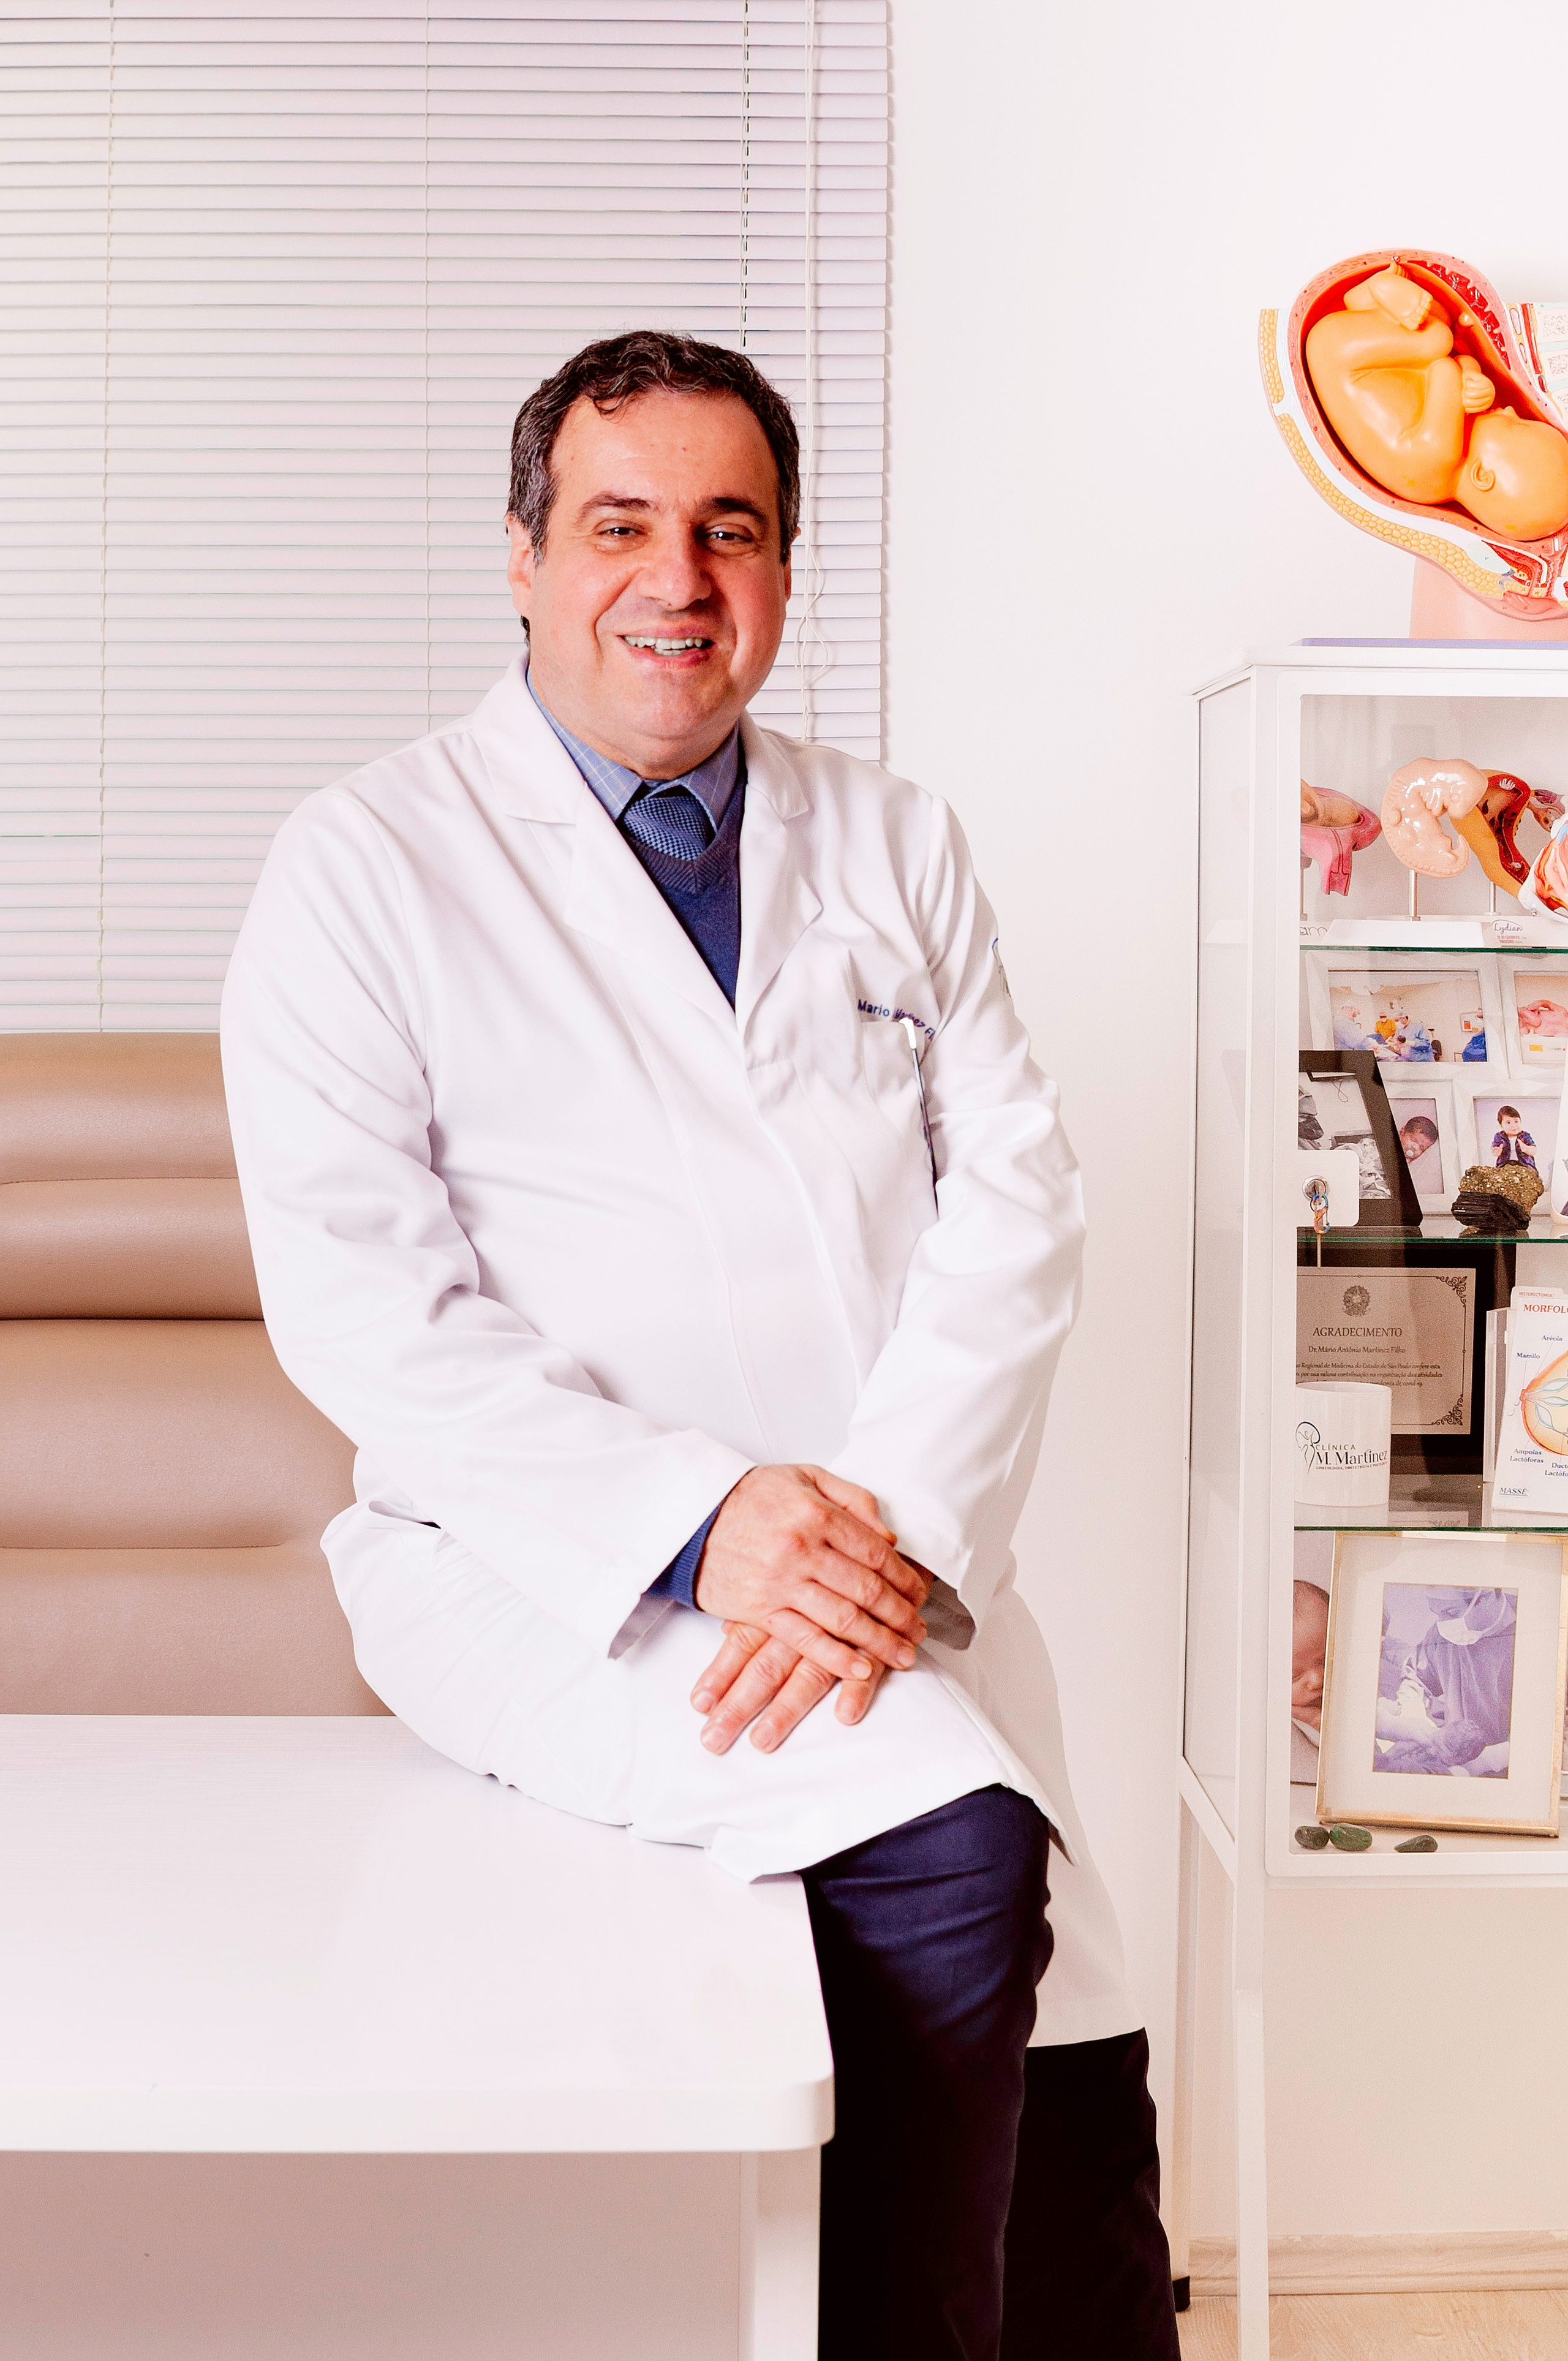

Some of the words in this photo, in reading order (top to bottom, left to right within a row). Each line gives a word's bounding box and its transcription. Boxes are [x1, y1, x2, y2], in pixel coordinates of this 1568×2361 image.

[858, 999, 890, 1017] Mario
[1523, 1304, 1568, 1313] MORFOL
[1313, 1327, 1403, 1337] AGRADECIMENTO
[1316, 1452, 1332, 1465] M.
[1336, 1449, 1387, 1465] Martinez
